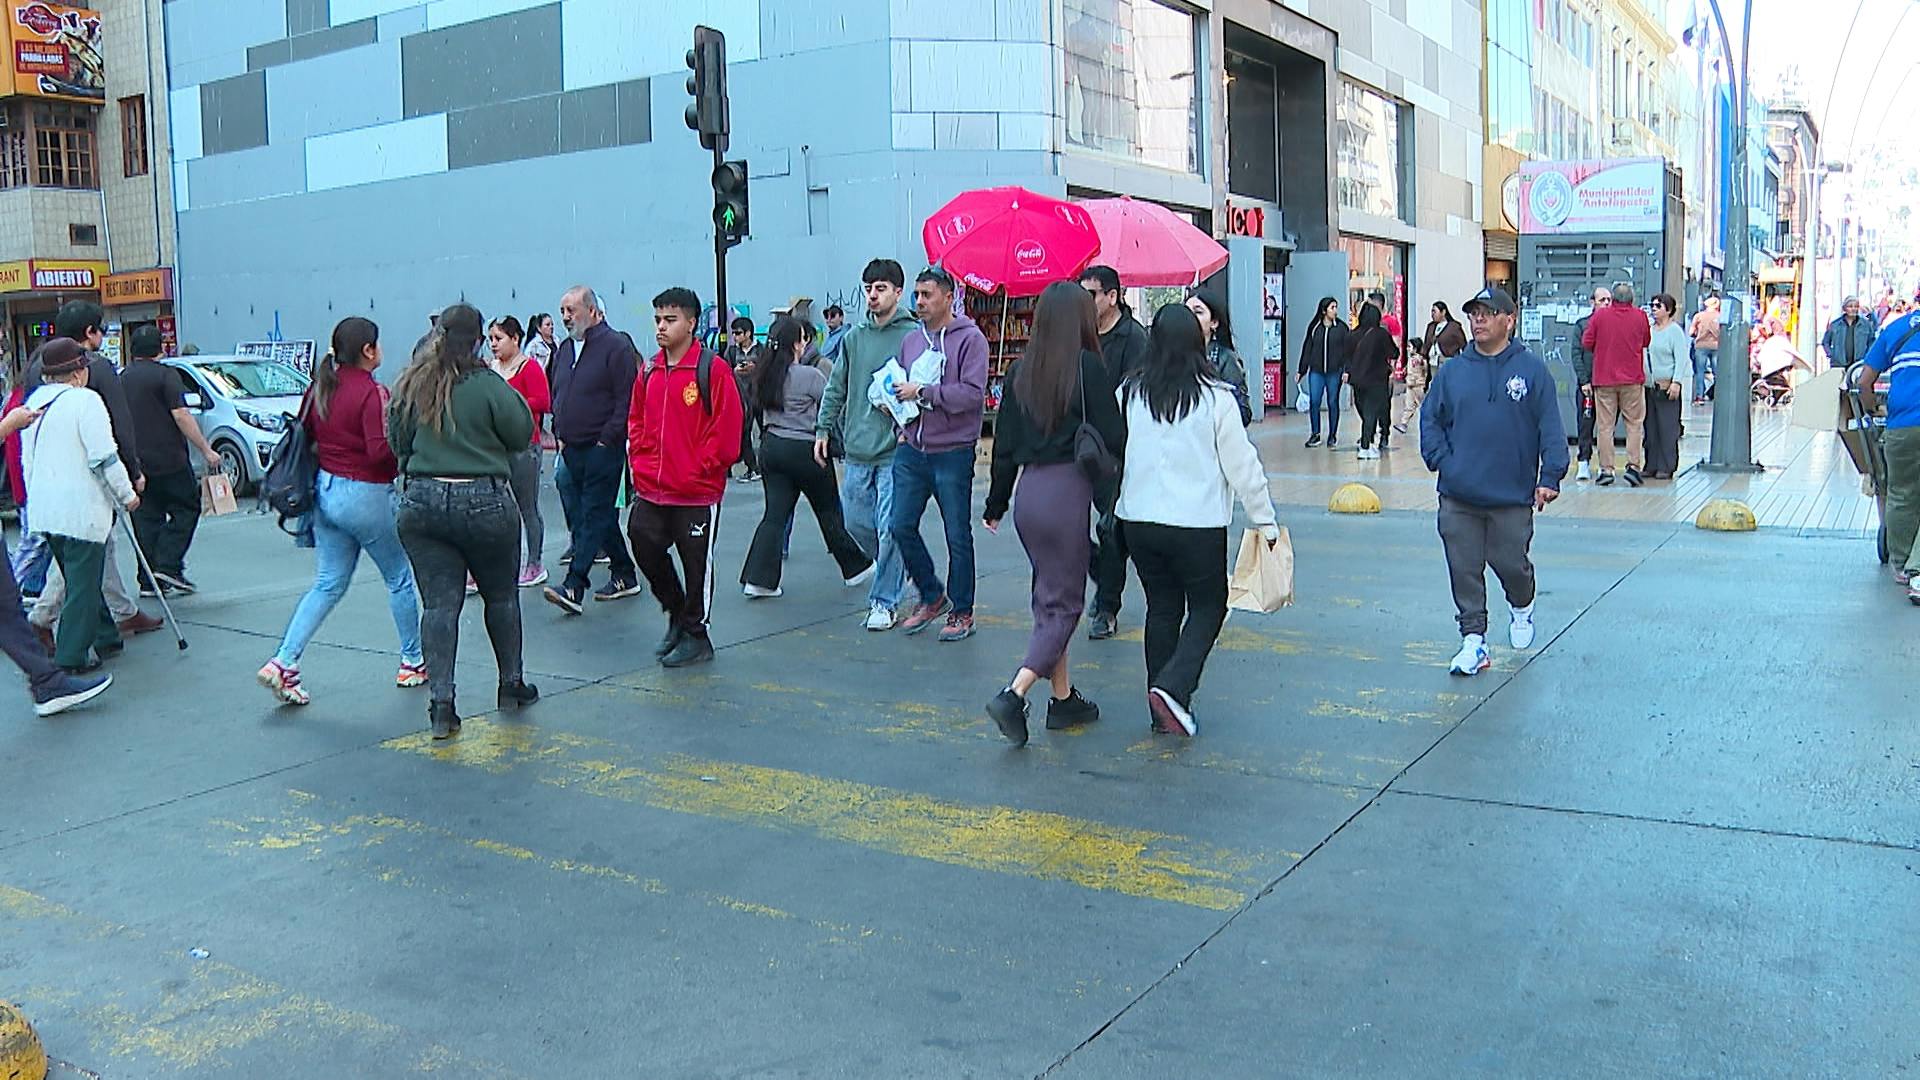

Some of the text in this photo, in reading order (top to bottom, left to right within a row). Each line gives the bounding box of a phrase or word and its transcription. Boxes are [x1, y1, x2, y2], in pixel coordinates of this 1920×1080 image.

[1578, 187, 1654, 198] Municipalidad
[36, 270, 93, 287] ABIERTO
[105, 277, 160, 298] RESTAURANT PISO 2
